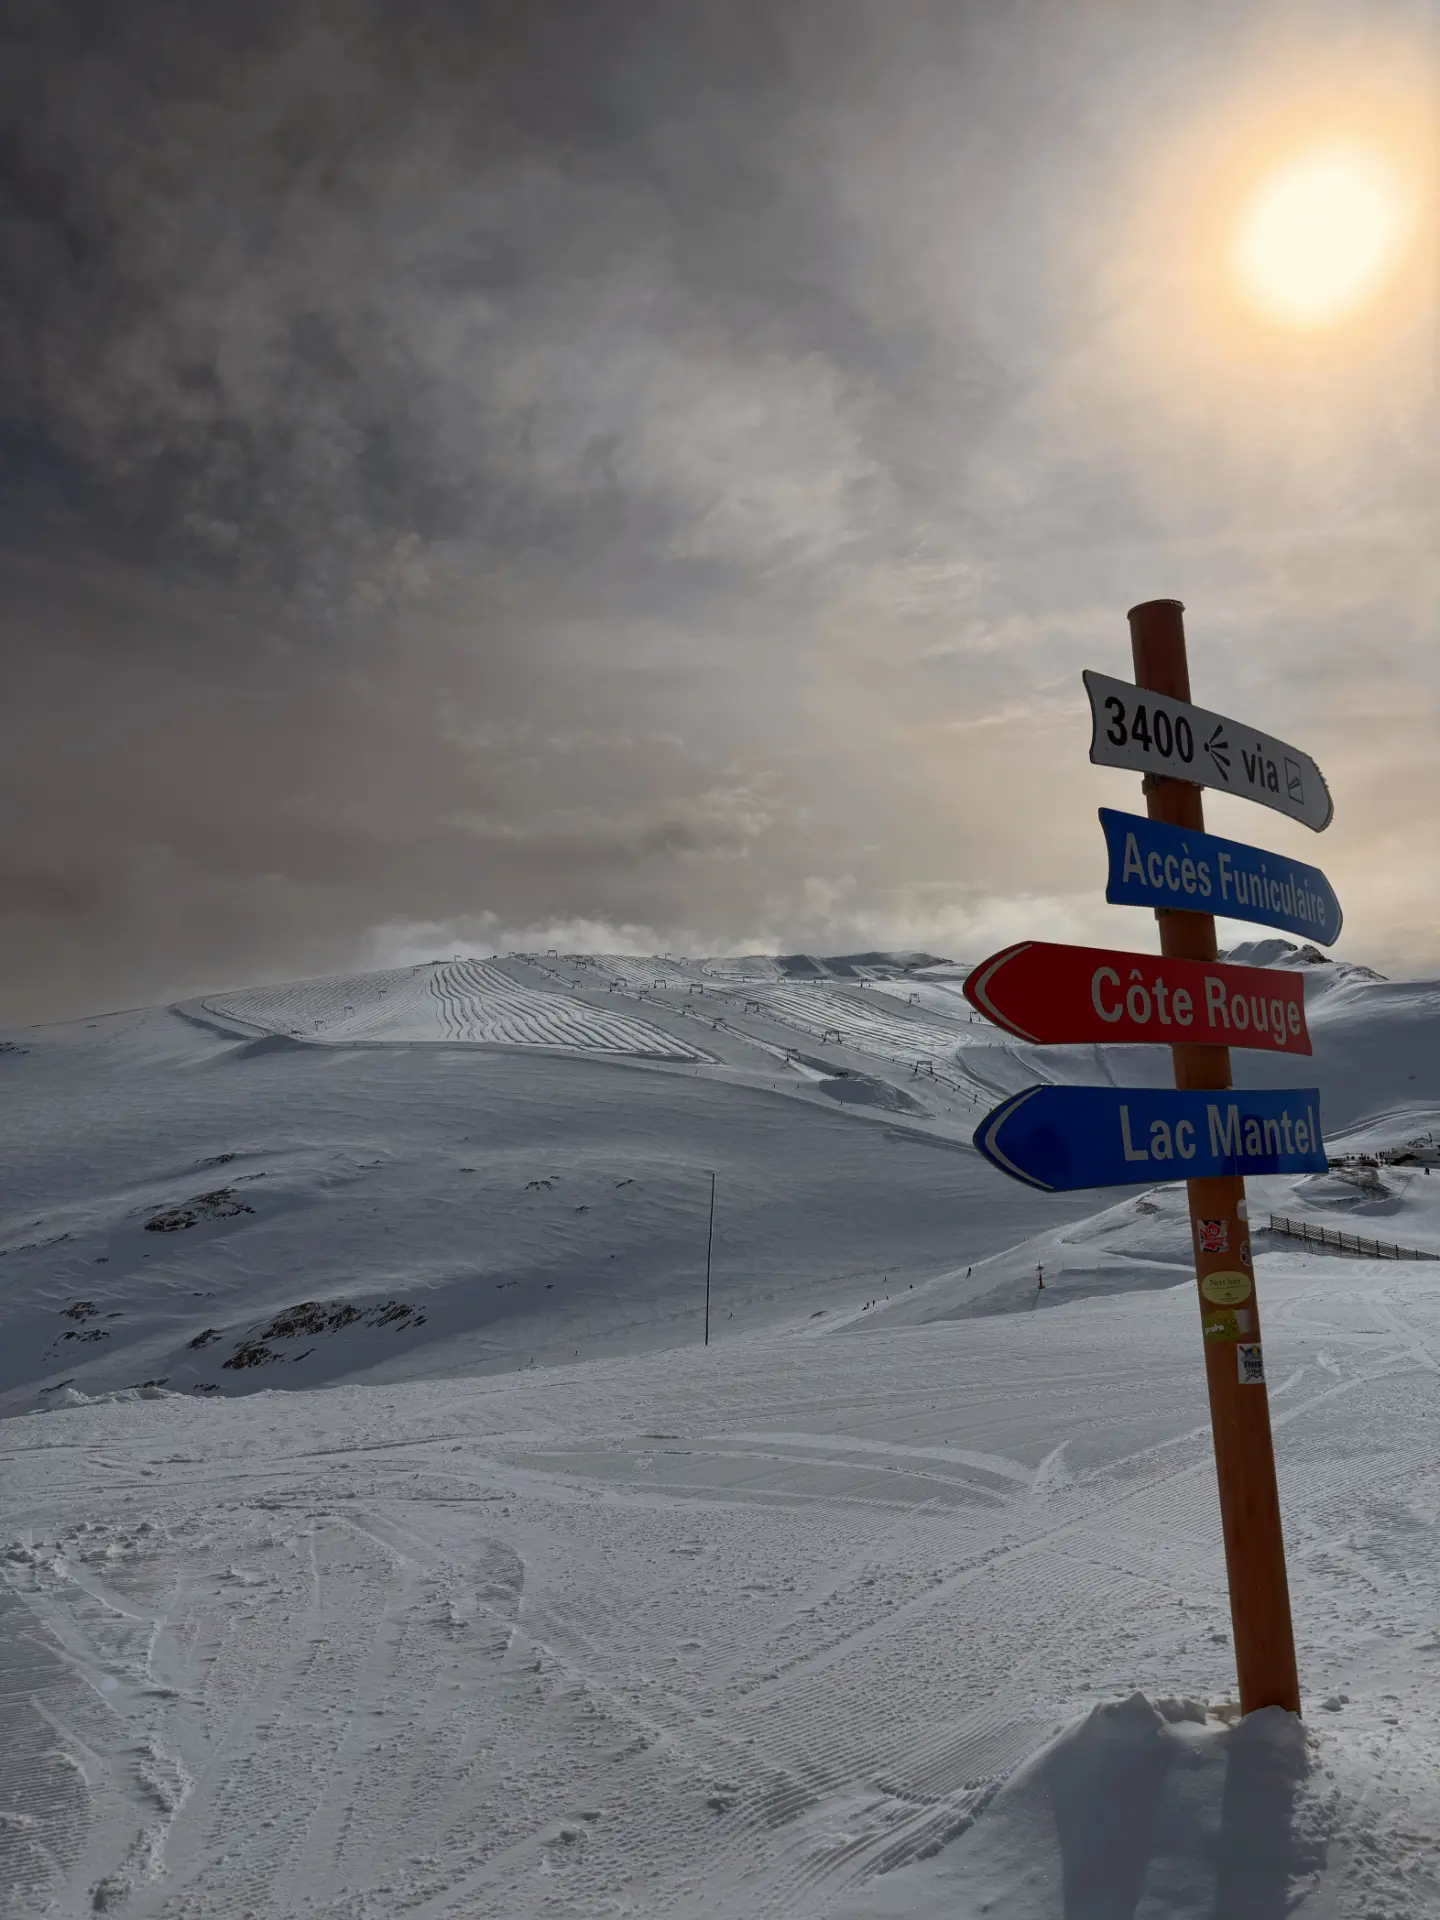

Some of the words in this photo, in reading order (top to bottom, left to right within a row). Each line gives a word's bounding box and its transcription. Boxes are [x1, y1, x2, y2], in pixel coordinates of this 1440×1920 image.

[1104, 696, 1194, 764] 3400
[1241, 743, 1280, 794] via
[1123, 832, 1212, 897] Accès
[1218, 852, 1326, 926] Funiculaire
[1091, 966, 1193, 1025] Côte
[1204, 976, 1301, 1045] Rouge
[1119, 1105, 1196, 1162] Lac
[1206, 1104, 1317, 1158] Mantel
